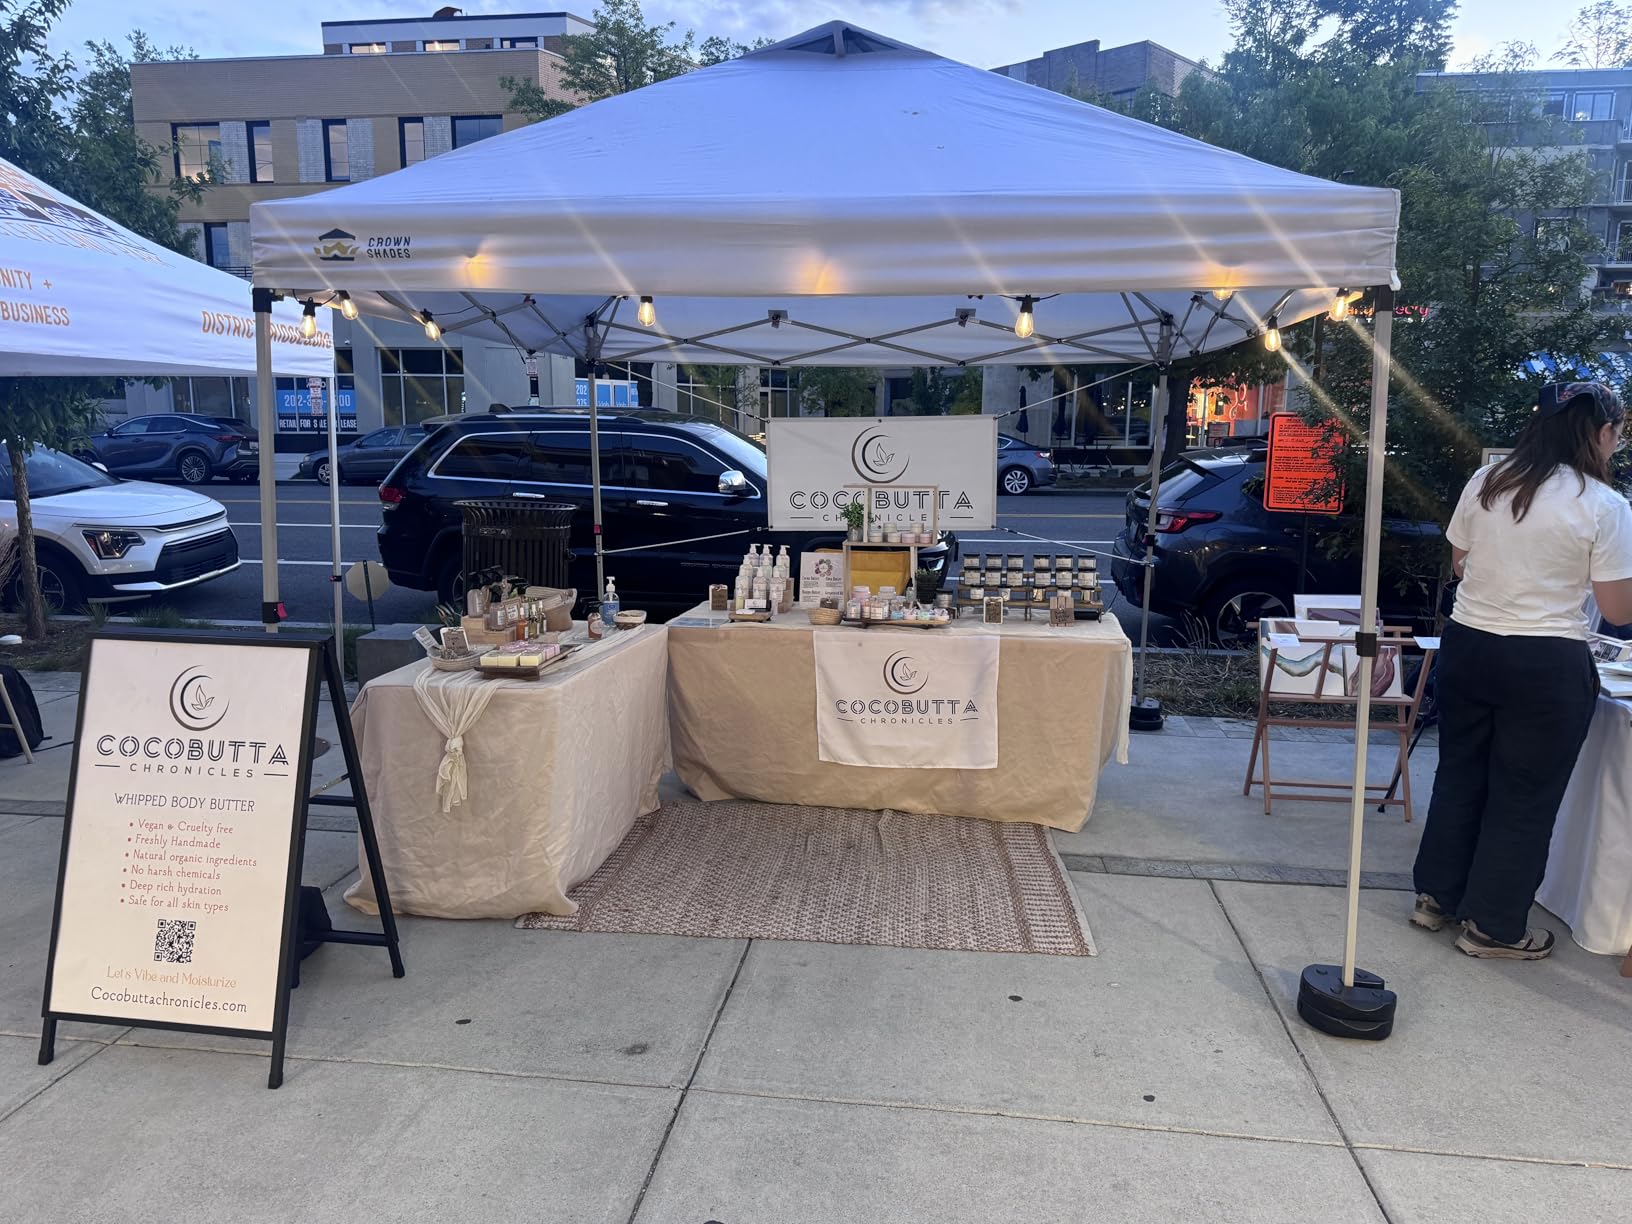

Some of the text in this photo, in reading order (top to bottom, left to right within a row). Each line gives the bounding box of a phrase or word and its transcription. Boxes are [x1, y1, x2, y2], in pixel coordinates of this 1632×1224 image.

[368, 236, 411, 248] CROWN
[366, 248, 411, 259] SHADES
[0, 268, 32, 290] NITY
[0, 301, 70, 326] BUSINESS
[279, 419, 297, 429] RETAIL
[300, 419, 311, 429] FOR
[340, 419, 357, 429] LEASE
[835, 699, 979, 715] COCOBUTTA
[860, 717, 953, 725] CHRONICLES
[96, 734, 289, 765] COCOBUTTA
[129, 762, 254, 778] CHRONICLES
[114, 793, 255, 812] WHIPPED BODY BUTTER
[138, 819, 164, 832] Vegan
[177, 821, 213, 836] Cruelty
[216, 822, 234, 834] free
[135, 834, 221, 849] Freshly Handmade
[133, 849, 257, 867] Natural organic ingredients
[131, 865, 221, 880] No harsh chemicals
[129, 880, 222, 896] Deep rich hydration
[128, 895, 229, 914] Safe for all skin types
[134, 968, 157, 982] Vibe
[160, 973, 179, 984] and
[181, 972, 237, 988] Moisturize
[91, 986, 247, 1013] Cocobuttachronicles.com
